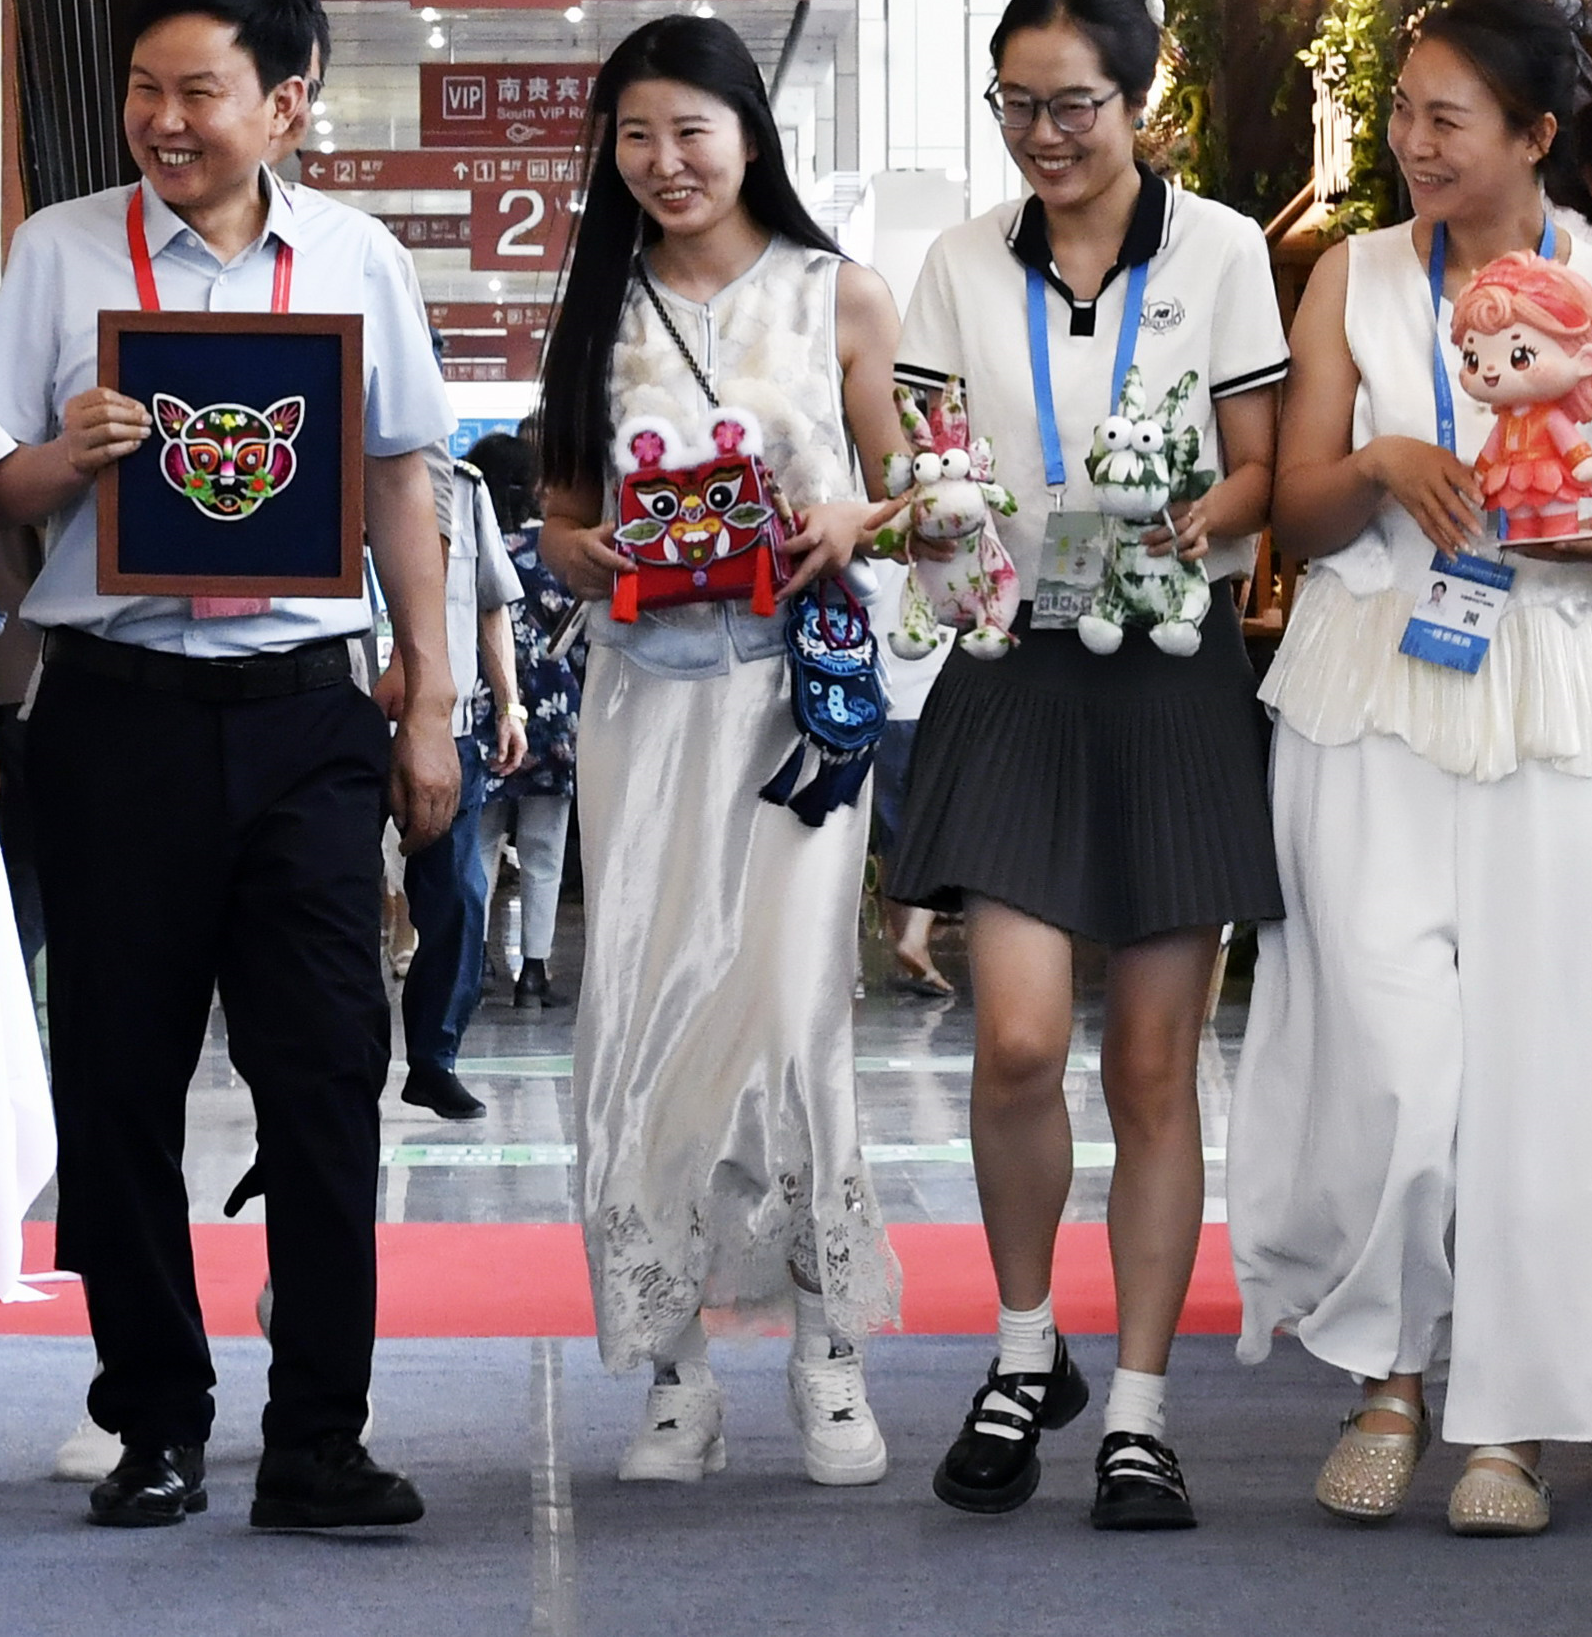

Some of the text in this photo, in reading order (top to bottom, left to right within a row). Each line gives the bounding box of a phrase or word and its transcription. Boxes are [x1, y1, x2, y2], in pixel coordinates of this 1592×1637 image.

[447, 85, 482, 111] VIP
[496, 106, 537, 121] South
[540, 107, 565, 120] VIP
[495, 188, 546, 258] 2
